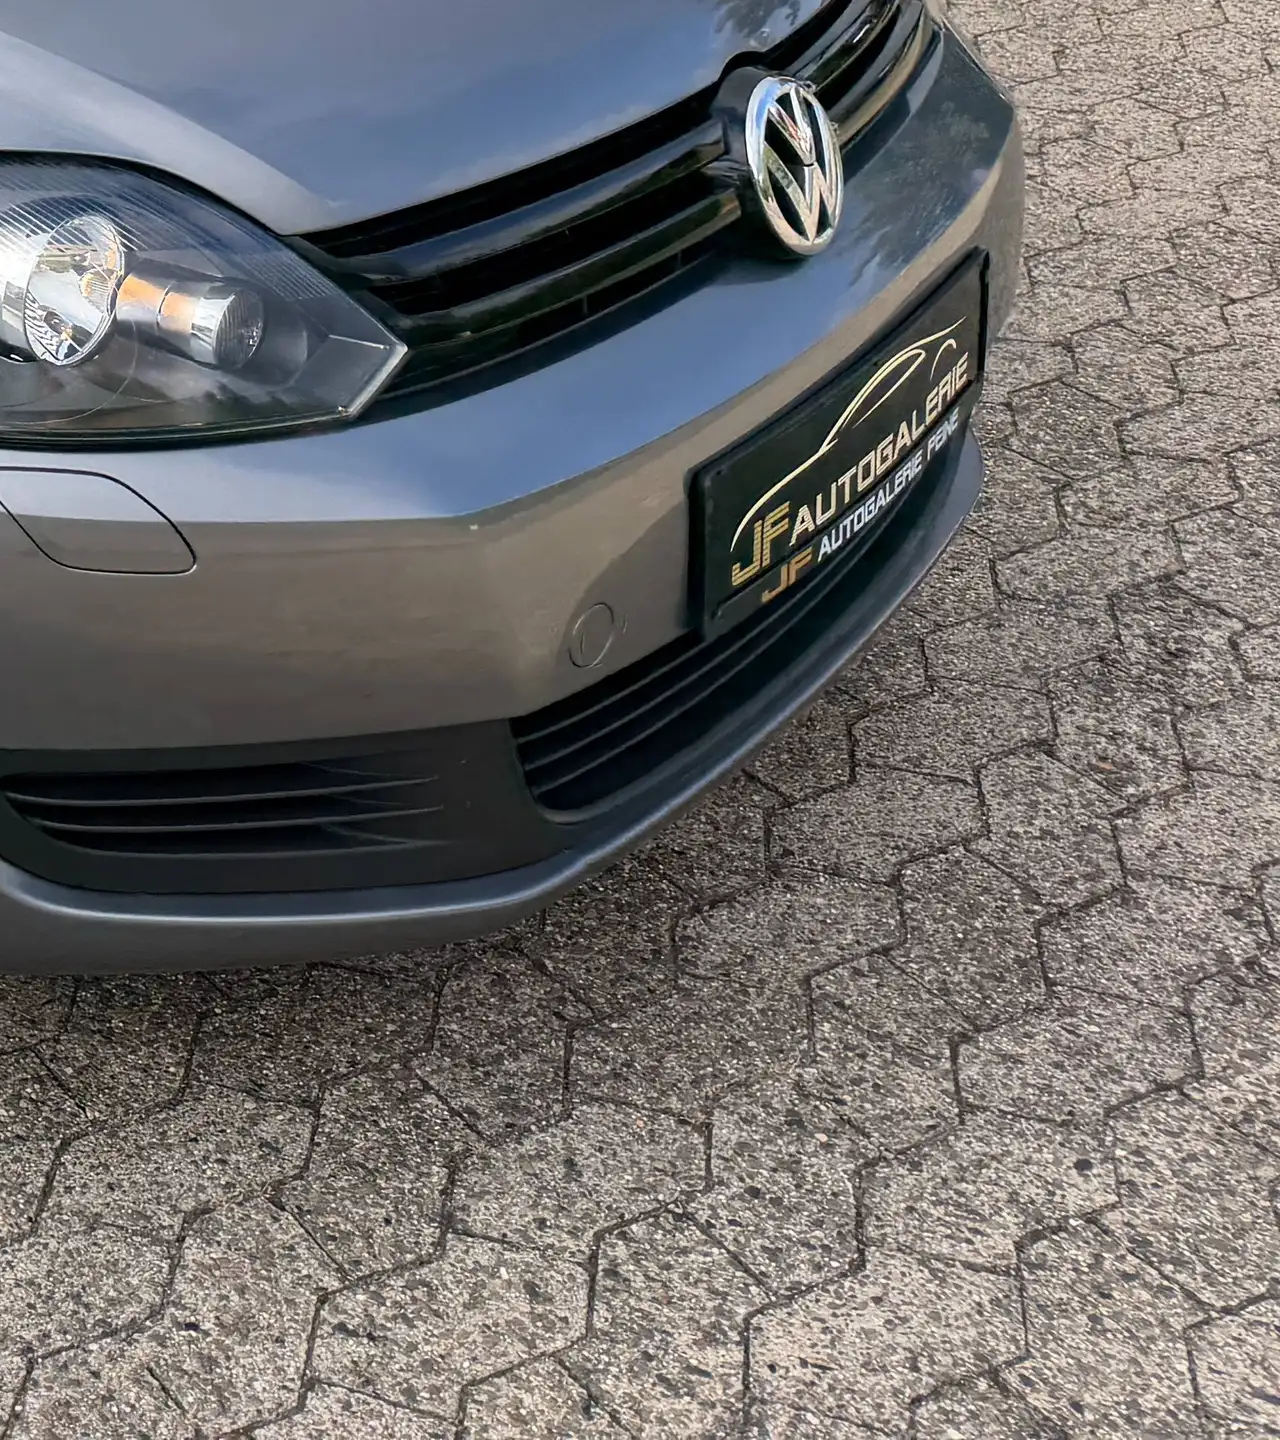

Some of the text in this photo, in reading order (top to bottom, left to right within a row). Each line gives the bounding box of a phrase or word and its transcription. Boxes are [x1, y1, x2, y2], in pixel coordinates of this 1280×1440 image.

[761, 546, 812, 603] JF
[817, 448, 923, 563] AUTOGALERIE
[788, 351, 969, 547] AUTOGALERIE
